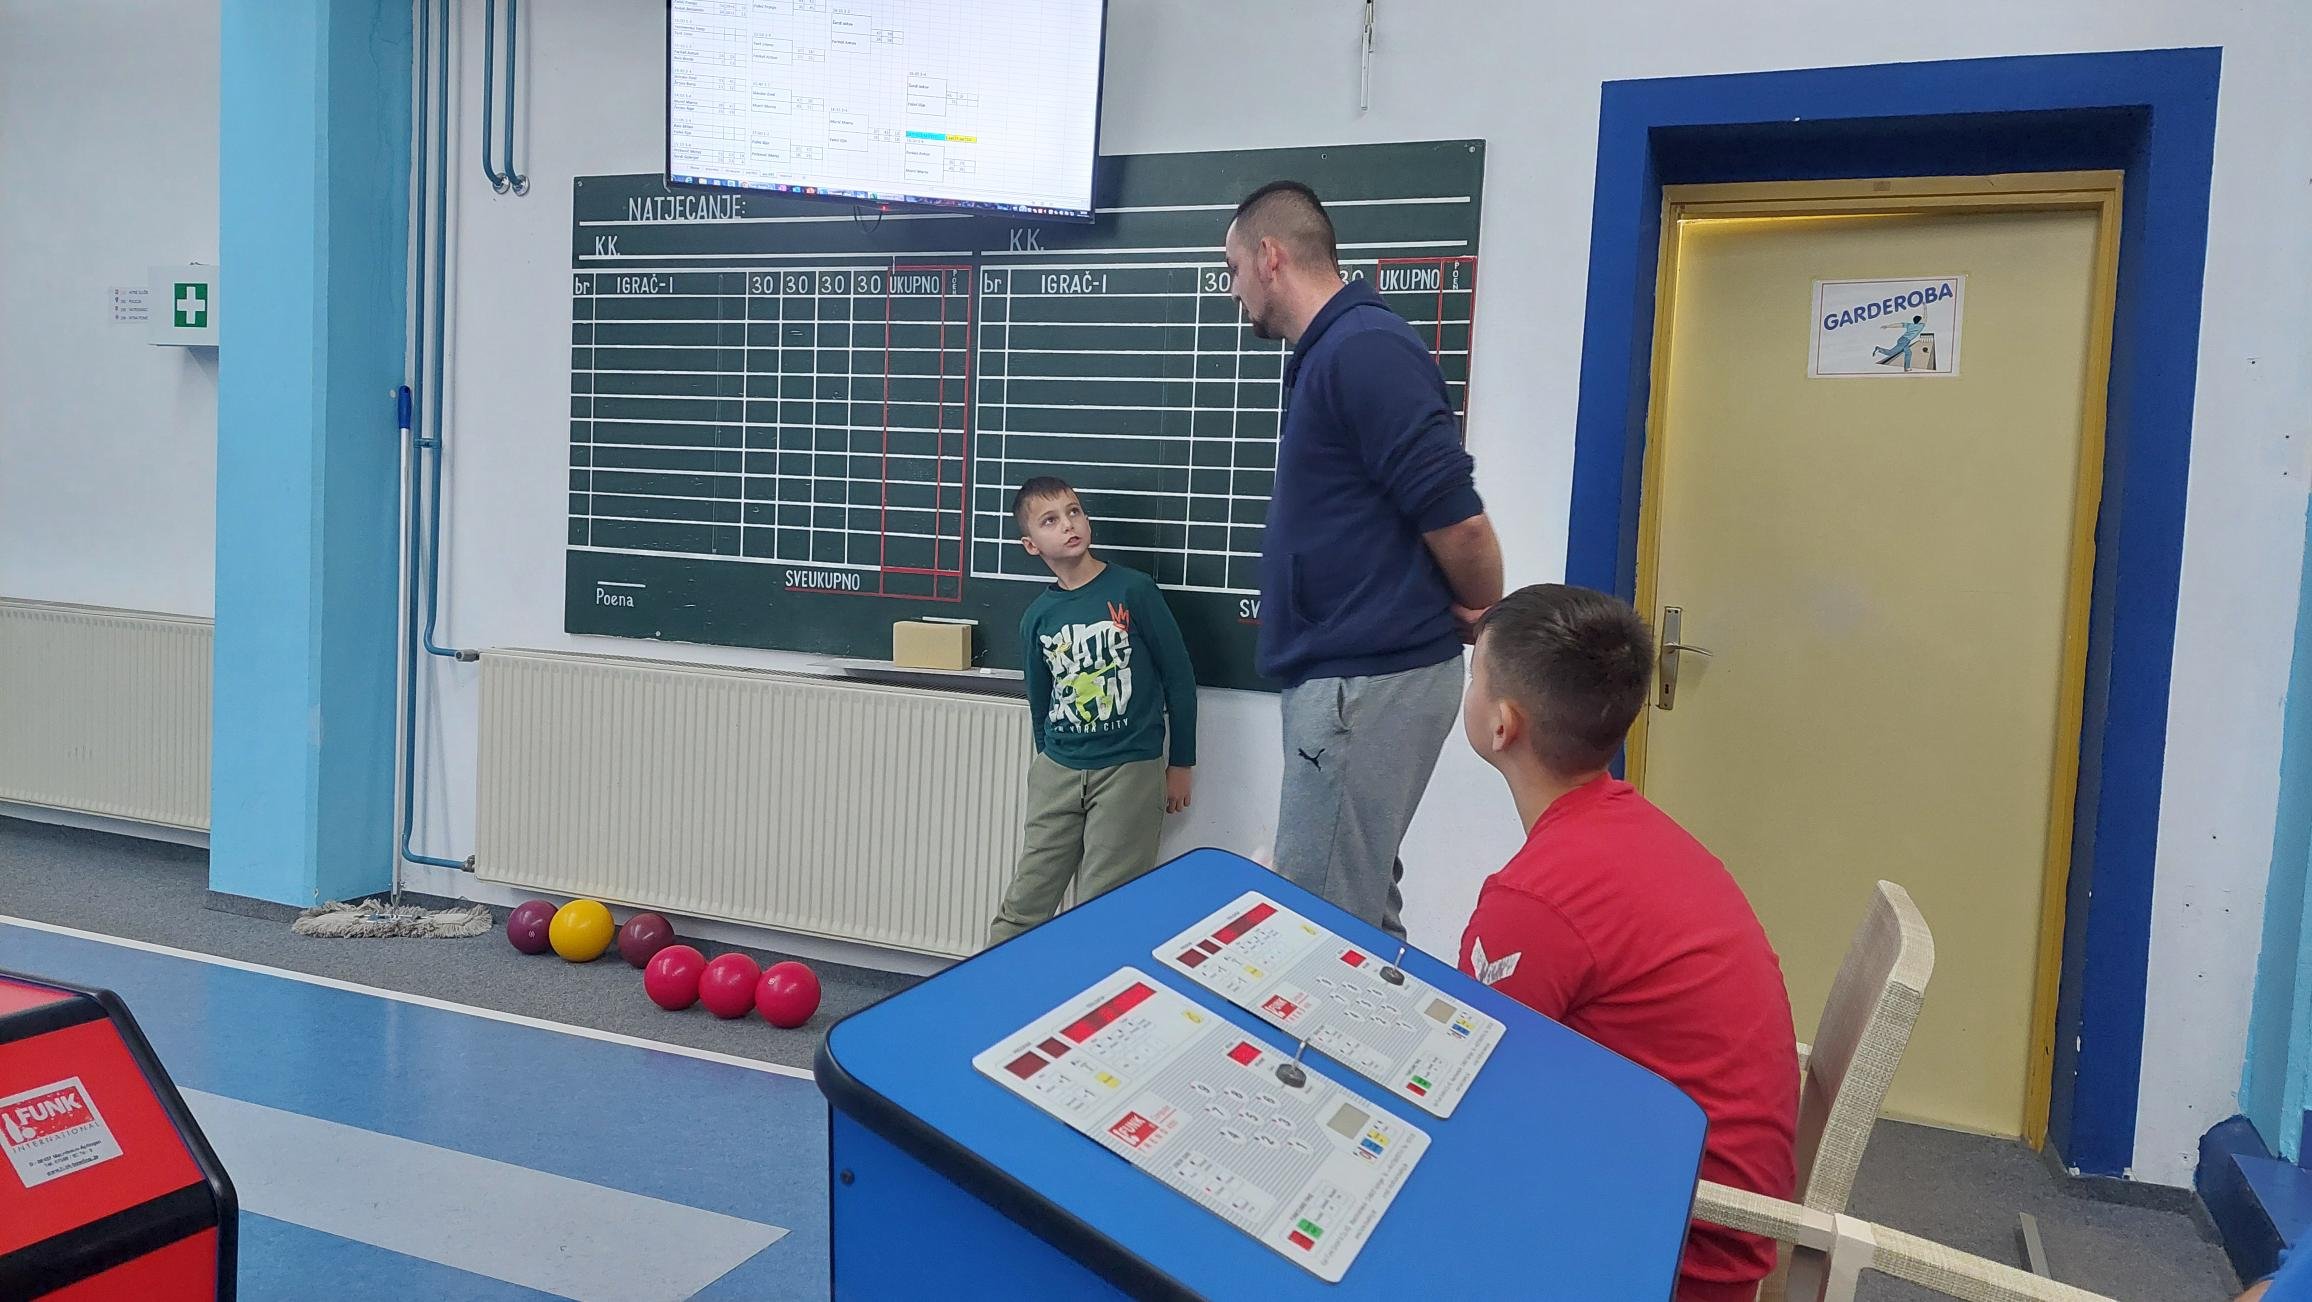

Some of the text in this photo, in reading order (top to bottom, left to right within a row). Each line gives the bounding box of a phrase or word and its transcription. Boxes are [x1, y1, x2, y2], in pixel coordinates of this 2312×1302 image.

[628, 194, 747, 221] NATJECANJE:
[575, 277, 590, 294] br
[751, 276, 774, 293] 30
[785, 275, 808, 293] 30
[821, 275, 845, 293] 30
[857, 275, 881, 293] 30
[889, 275, 940, 293] UKUPNO
[983, 273, 1002, 293] br
[1204, 272, 1231, 292] 30
[1379, 268, 1440, 290] UKUPNO
[1823, 282, 1954, 331] GARDEROBA
[784, 569, 861, 591] SVEUKUPNO
[595, 587, 635, 608] Poena
[1103, 717, 1129, 732] CITY
[14, 1092, 82, 1126] FUNK
